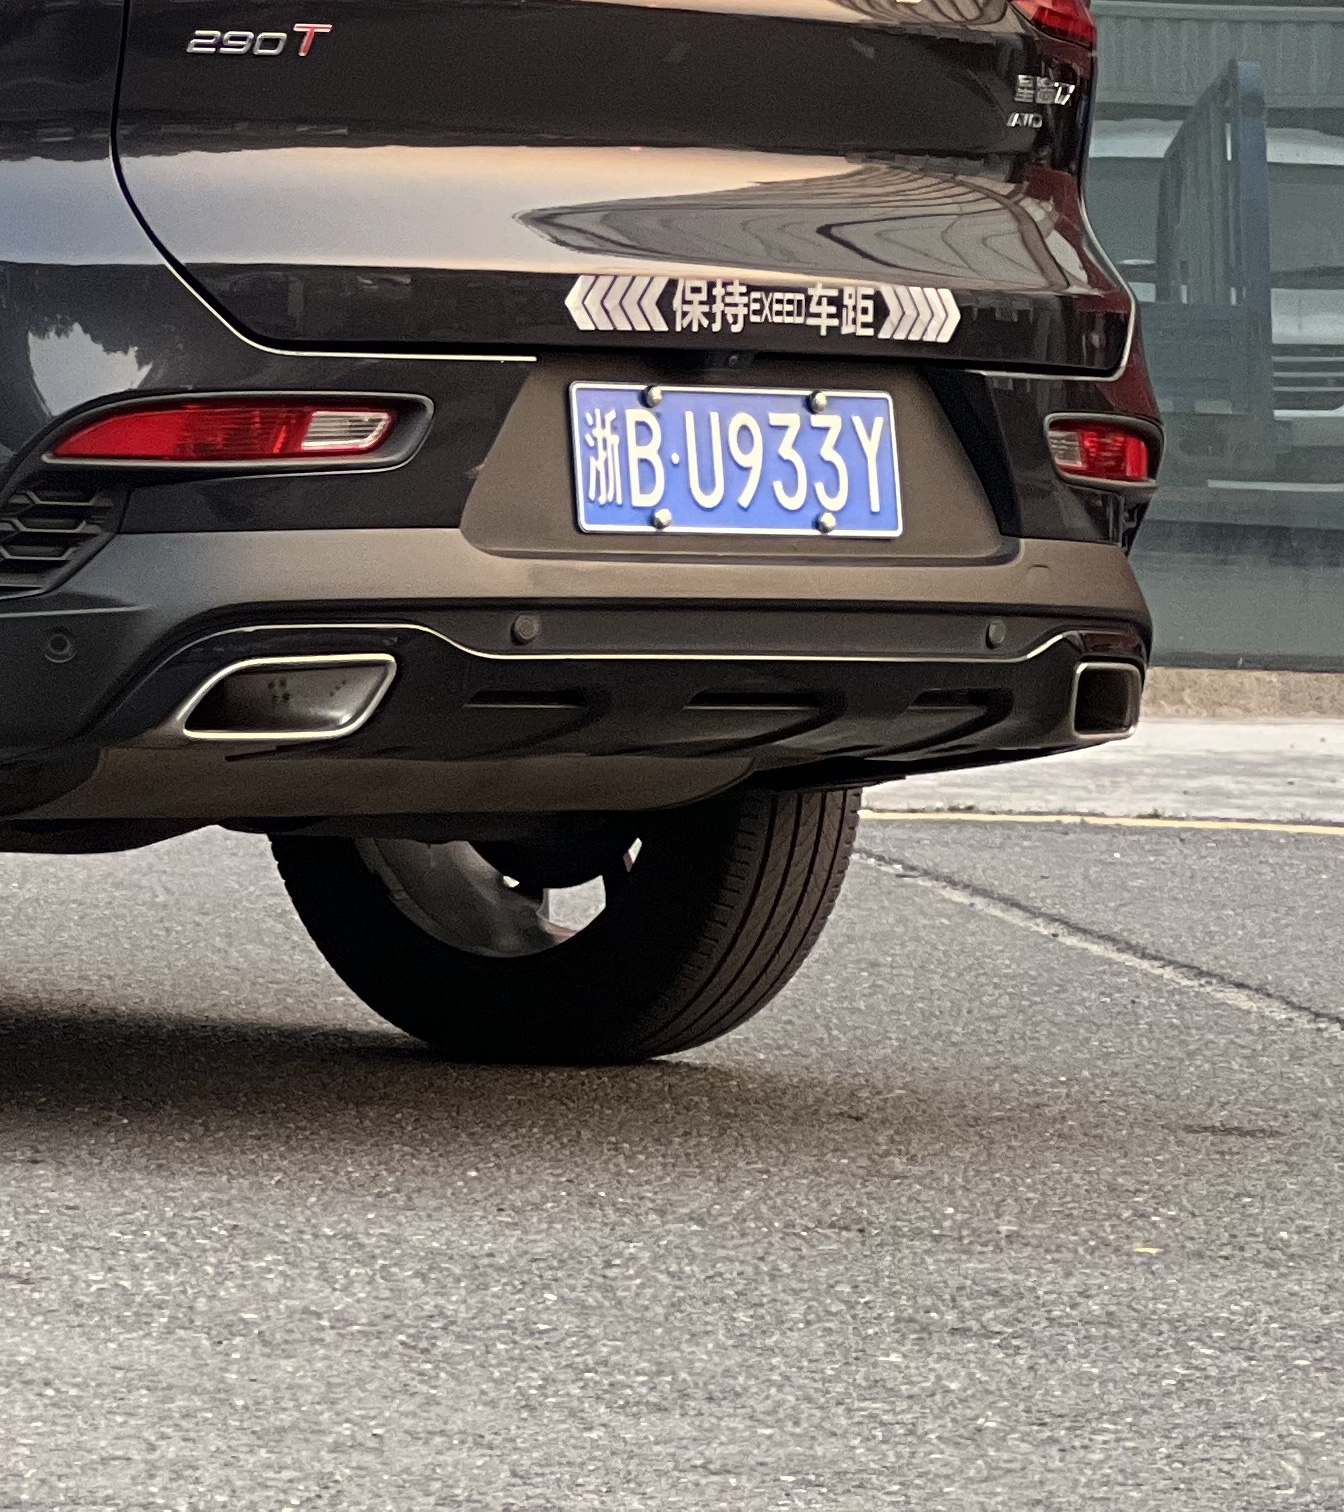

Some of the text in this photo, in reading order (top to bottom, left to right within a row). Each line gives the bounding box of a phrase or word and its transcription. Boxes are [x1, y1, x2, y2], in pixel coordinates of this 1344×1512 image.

[185, 23, 333, 58] 290T
[672, 278, 876, 338] 保持EXEED车距
